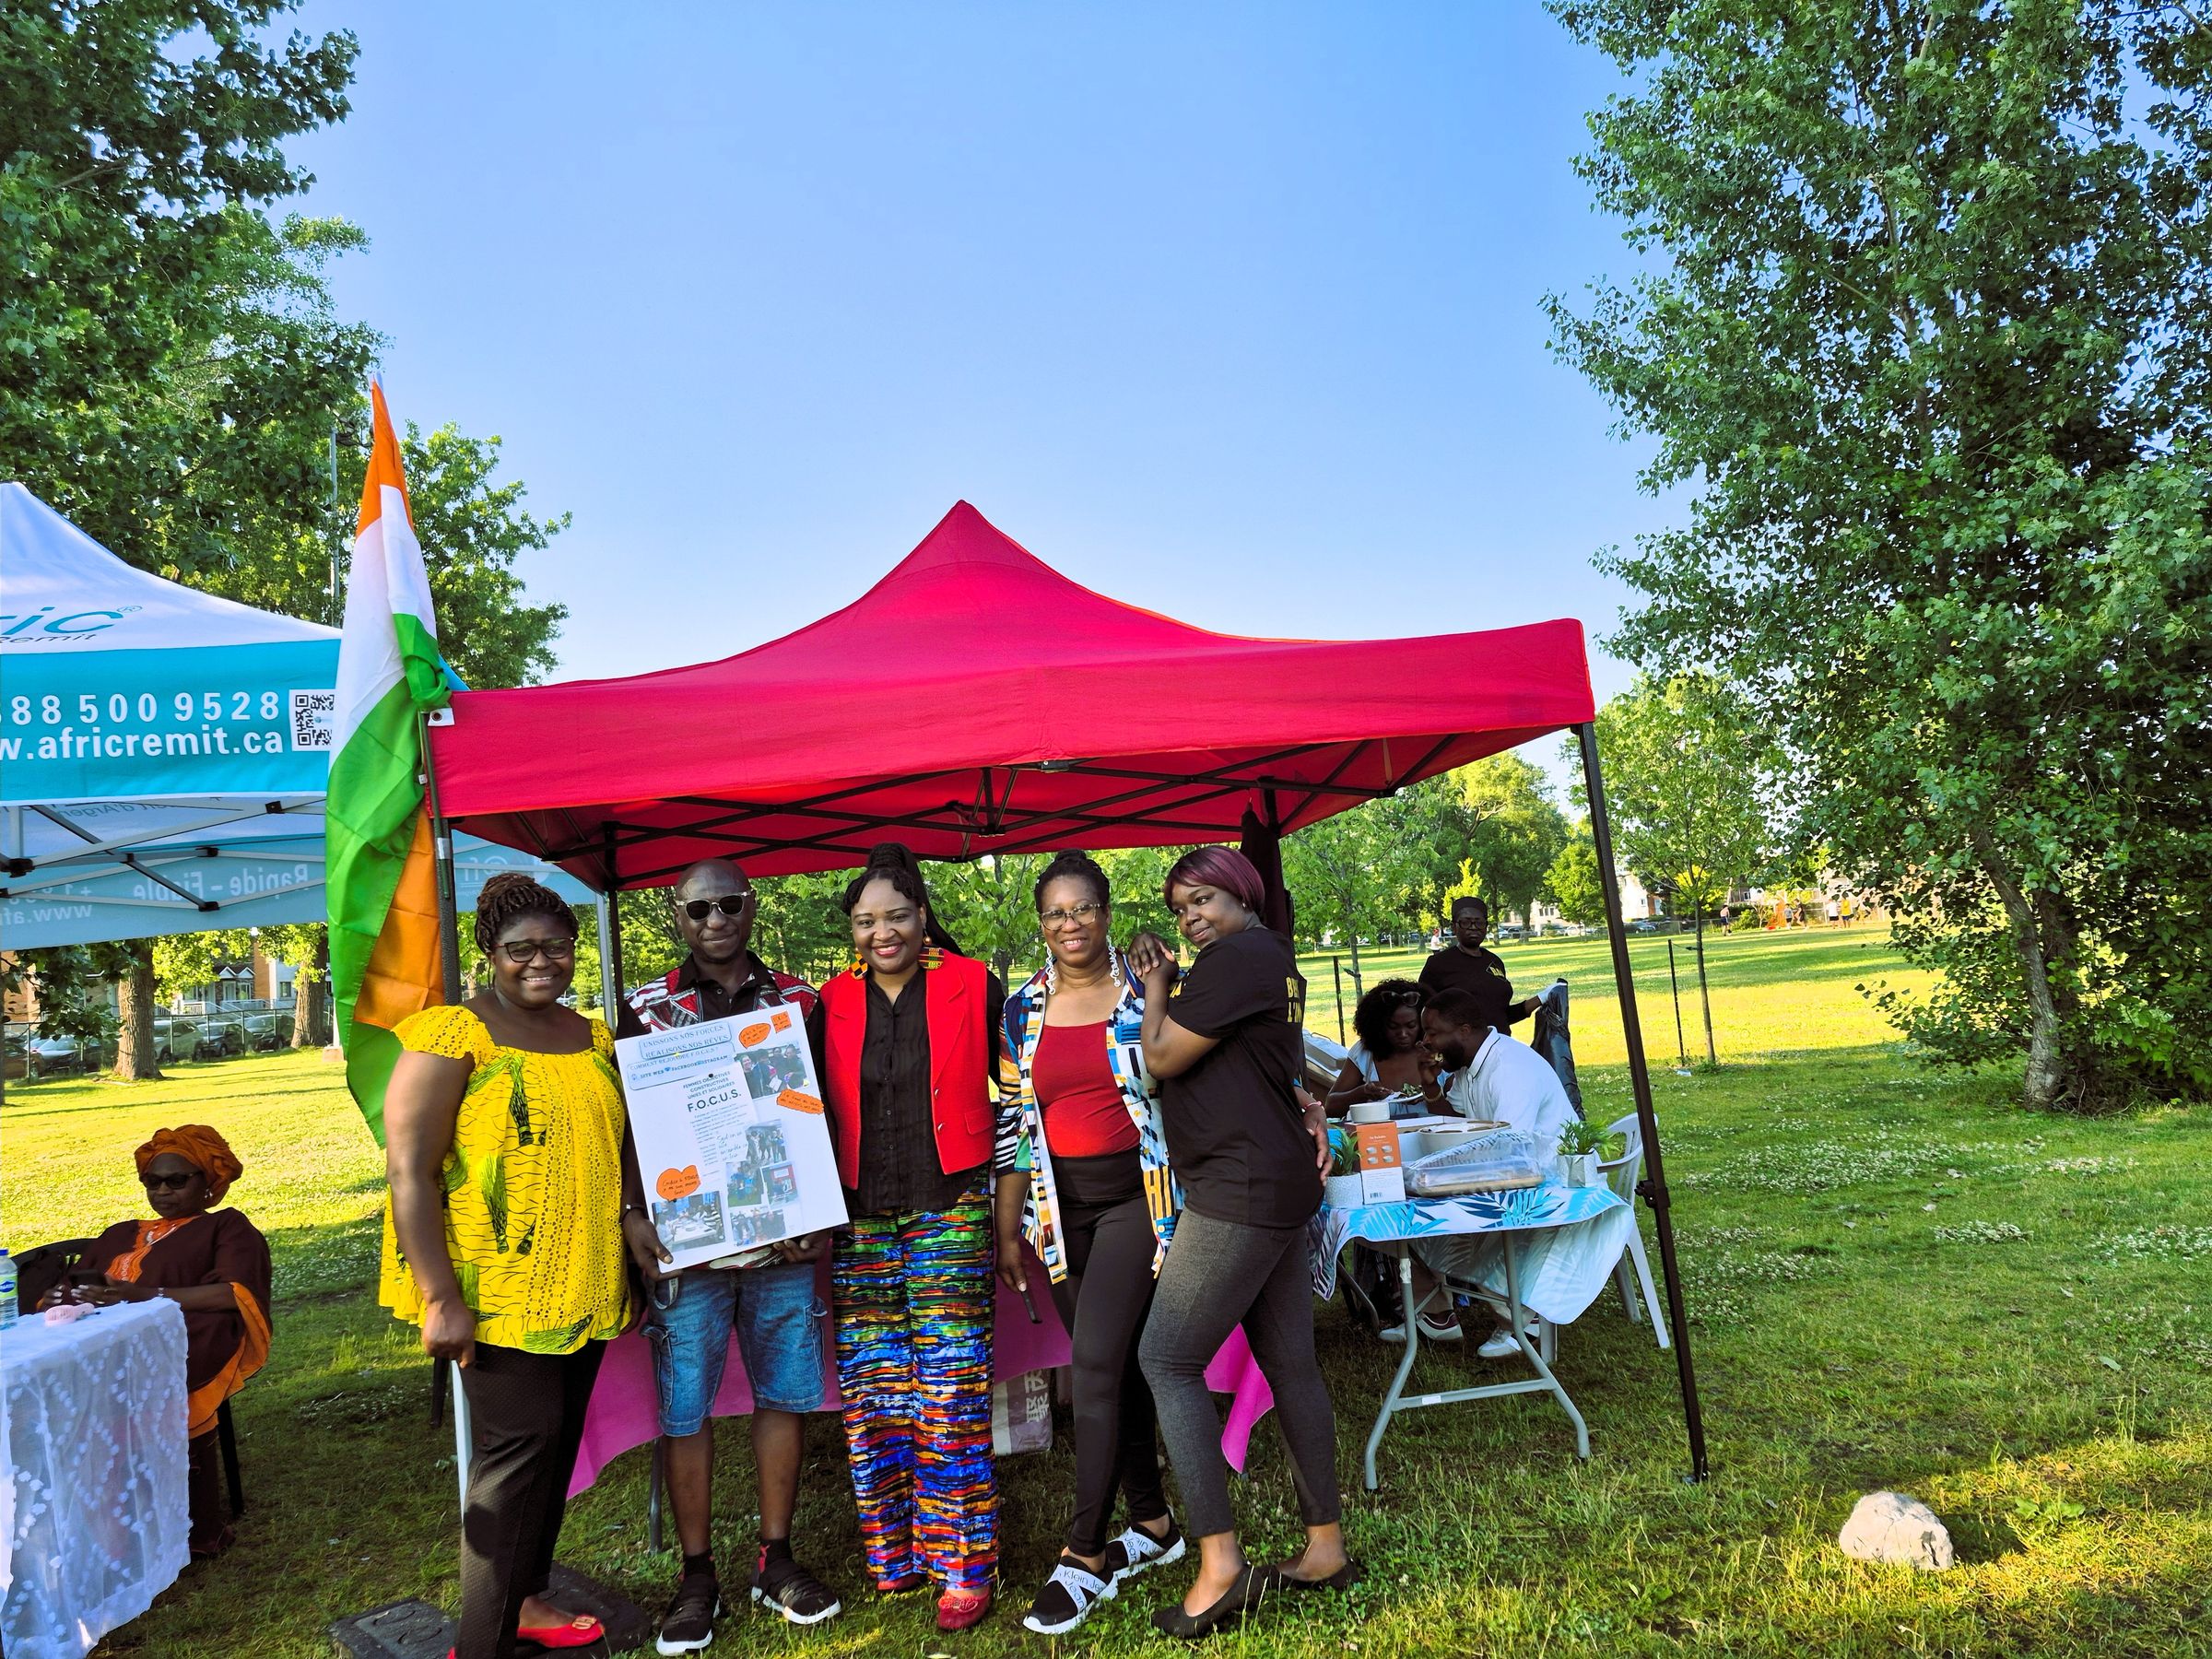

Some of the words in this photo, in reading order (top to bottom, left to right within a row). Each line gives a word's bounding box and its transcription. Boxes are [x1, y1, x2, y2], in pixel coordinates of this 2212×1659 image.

[79, 692, 158, 724] 500
[173, 691, 280, 723] 9528
[642, 1034, 677, 1047] UNISSONS
[679, 1030, 694, 1040] NOS
[688, 1040, 702, 1048] NOS
[671, 1061, 700, 1071] FACEBOOK
[683, 1079, 701, 1088] FEMMES
[690, 1077, 729, 1092] CONSTRUCTIVES
[708, 1081, 735, 1093] SOLIDAIRES
[688, 1088, 741, 1112] F.O.C.U.S.
[1064, 1570, 1088, 1585] Klein
